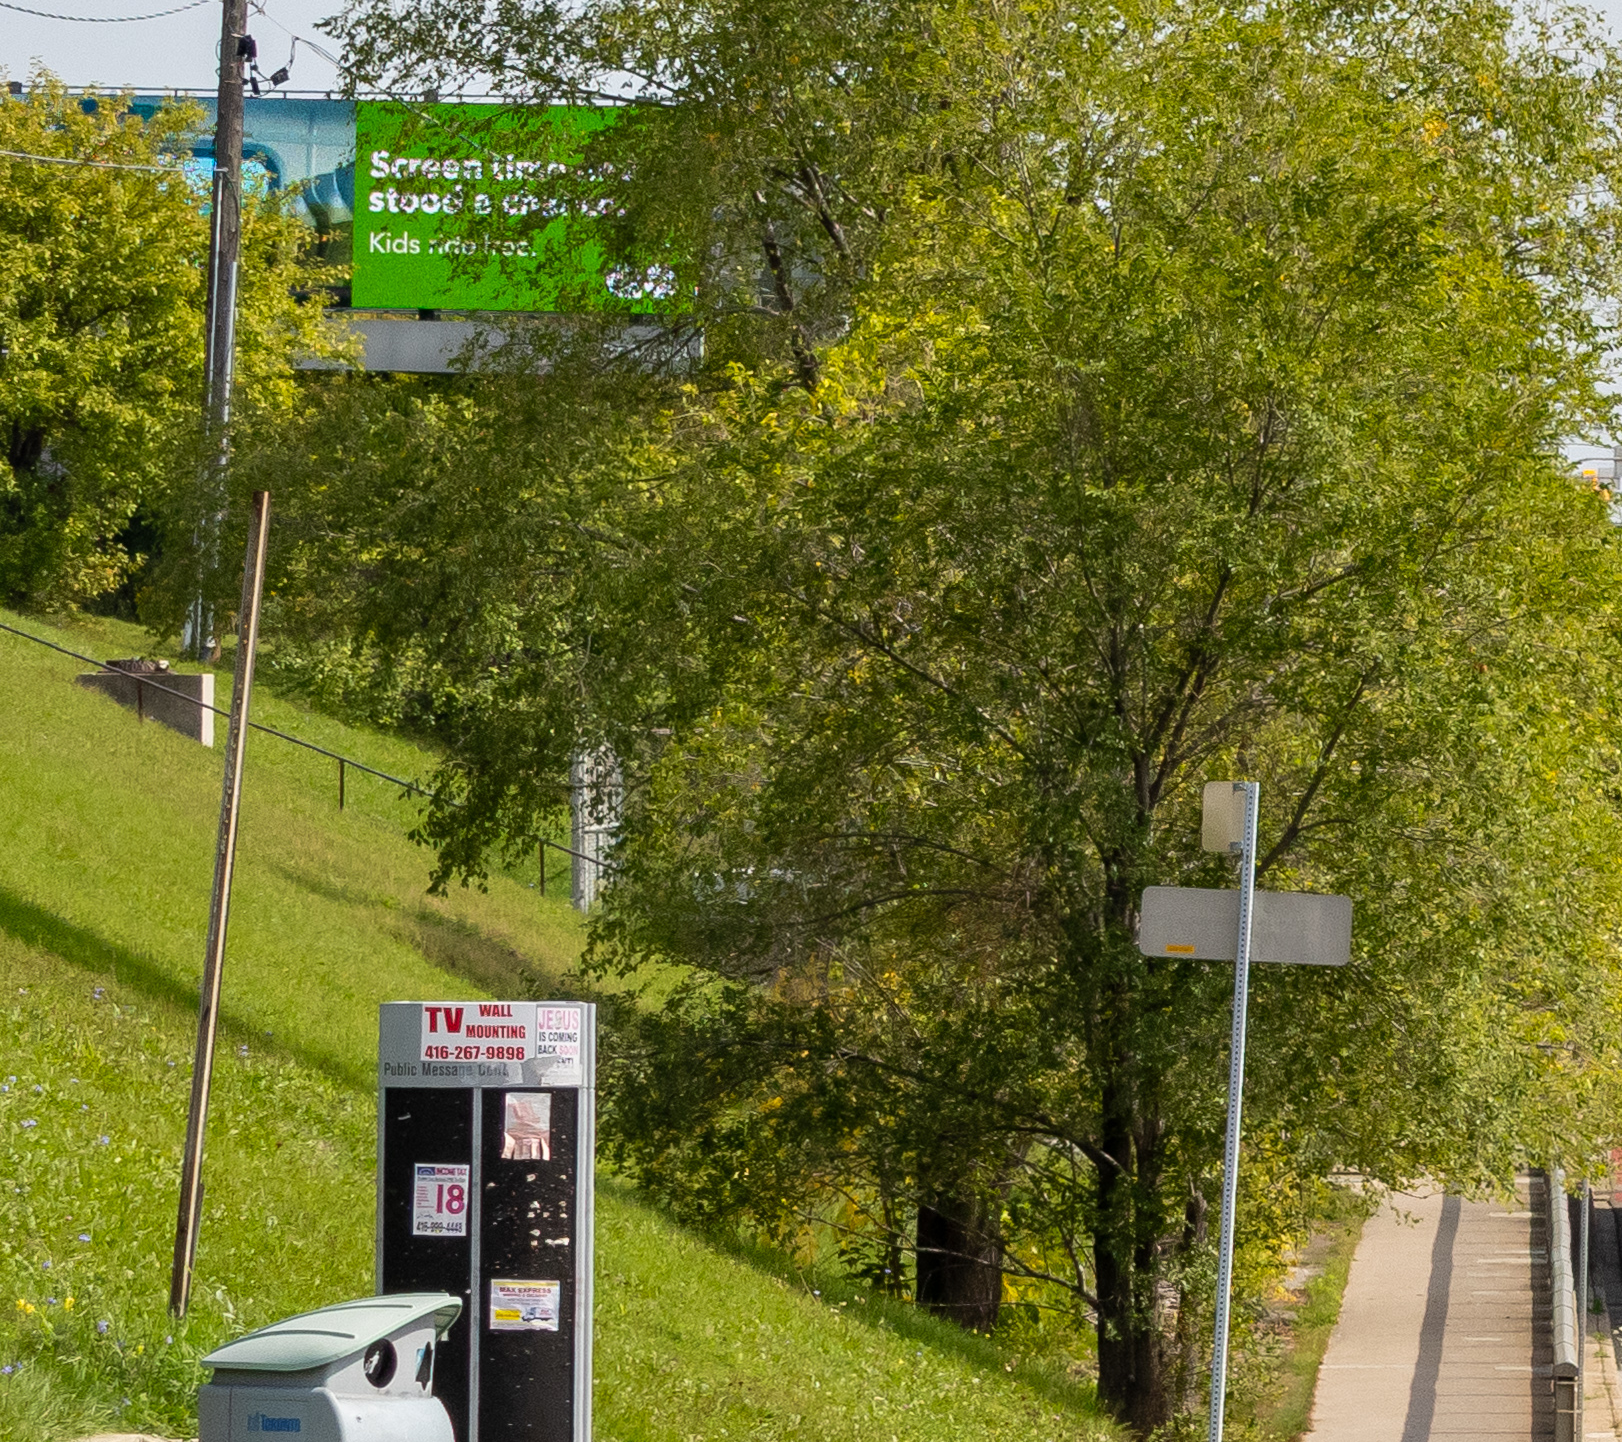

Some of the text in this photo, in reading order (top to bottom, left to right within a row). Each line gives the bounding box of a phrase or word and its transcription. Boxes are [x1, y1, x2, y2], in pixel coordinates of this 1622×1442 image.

[369, 150, 483, 180] Screen
[368, 184, 464, 215] stood
[474, 192, 492, 214] a
[369, 231, 420, 254] Kids
[478, 1004, 513, 1017] WALL
[424, 1006, 464, 1034] TV
[538, 1010, 579, 1030] JESUS
[465, 1024, 527, 1039] MOUNTING
[538, 1032, 578, 1042] IS COMING
[424, 1045, 526, 1060] 416-267-9898
[538, 1045, 579, 1055] BACK SOON
[383, 1062, 417, 1077] Public
[421, 1062, 474, 1079] Message
[436, 1183, 465, 1215] 18
